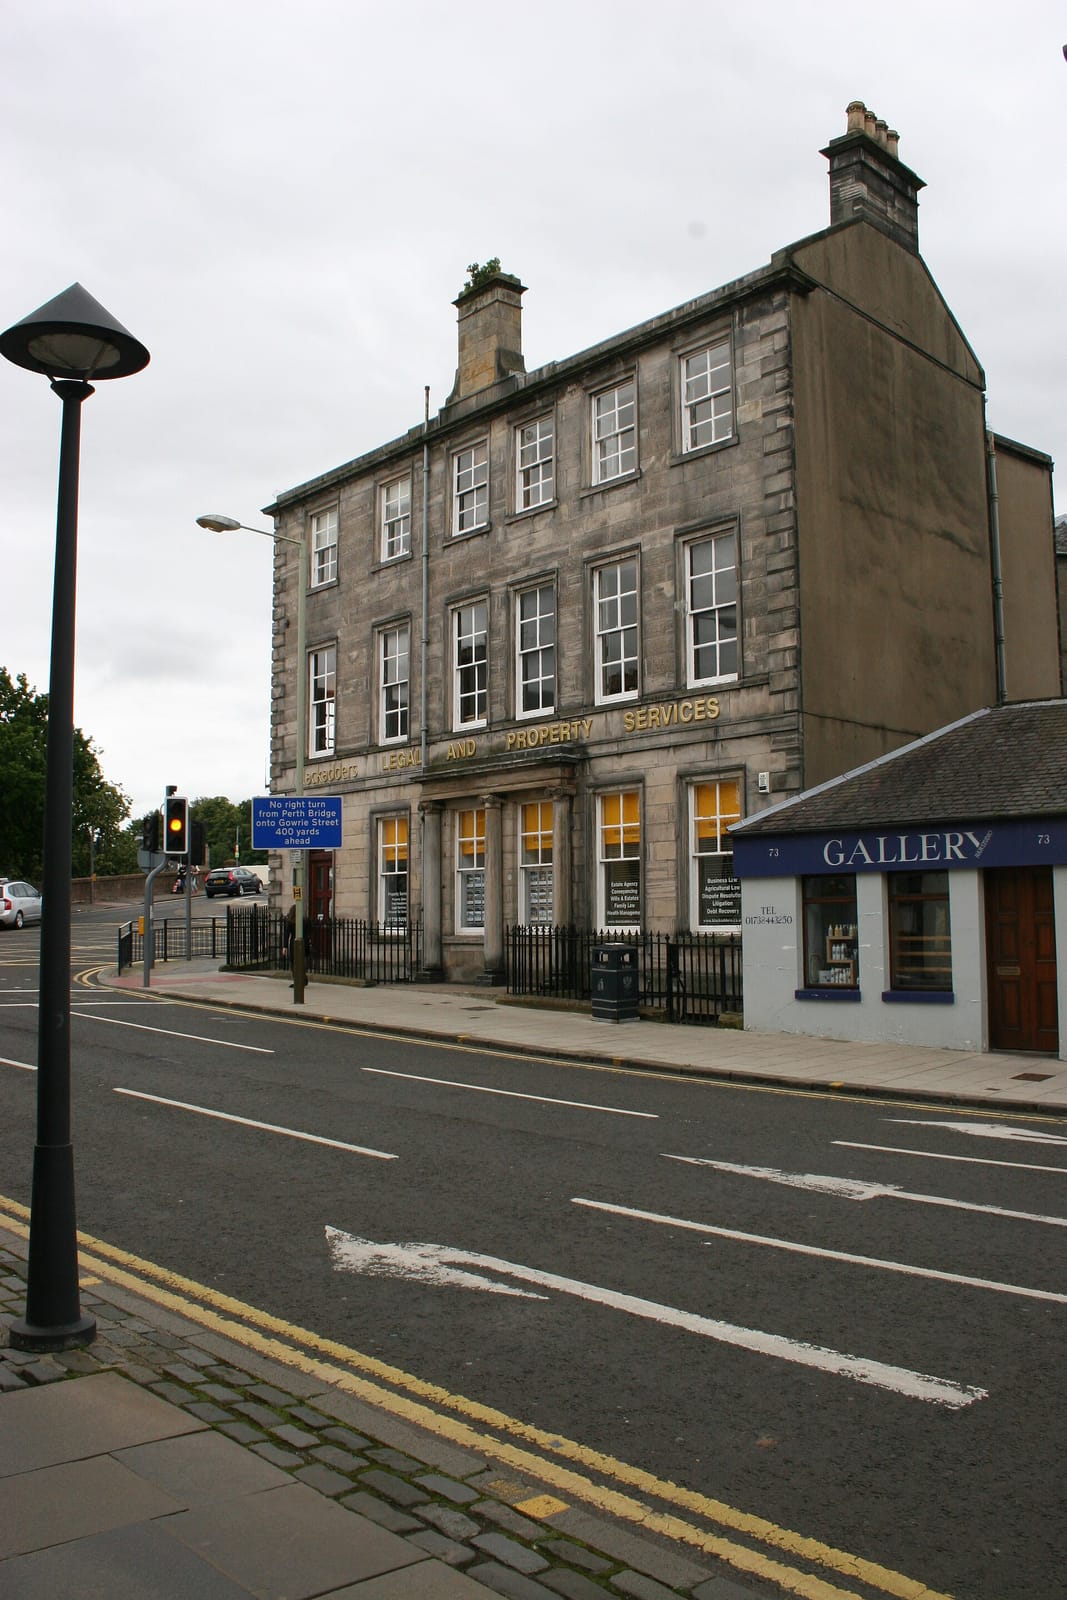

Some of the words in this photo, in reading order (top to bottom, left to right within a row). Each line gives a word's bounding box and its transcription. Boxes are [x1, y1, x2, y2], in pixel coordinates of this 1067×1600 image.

[302, 762, 359, 785] lackadders
[382, 748, 422, 771] LEGAL
[446, 739, 477, 761] AND
[506, 719, 593, 750] PROPERTY
[623, 697, 720, 732] SERVICES
[269, 801, 282, 809] No
[285, 801, 305, 810] right
[259, 810, 279, 818] from
[308, 809, 337, 818] Bridge
[255, 819, 276, 827] onto
[278, 819, 309, 827] Gowrie
[311, 818, 339, 826] Street
[296, 828, 320, 837] yards
[284, 837, 311, 845] ahead
[1037, 835, 1050, 845] 73
[768, 847, 779, 857] 73
[823, 831, 981, 866] GALLERY
[293, 887, 301, 898] H
[760, 906, 777, 915] TEL
